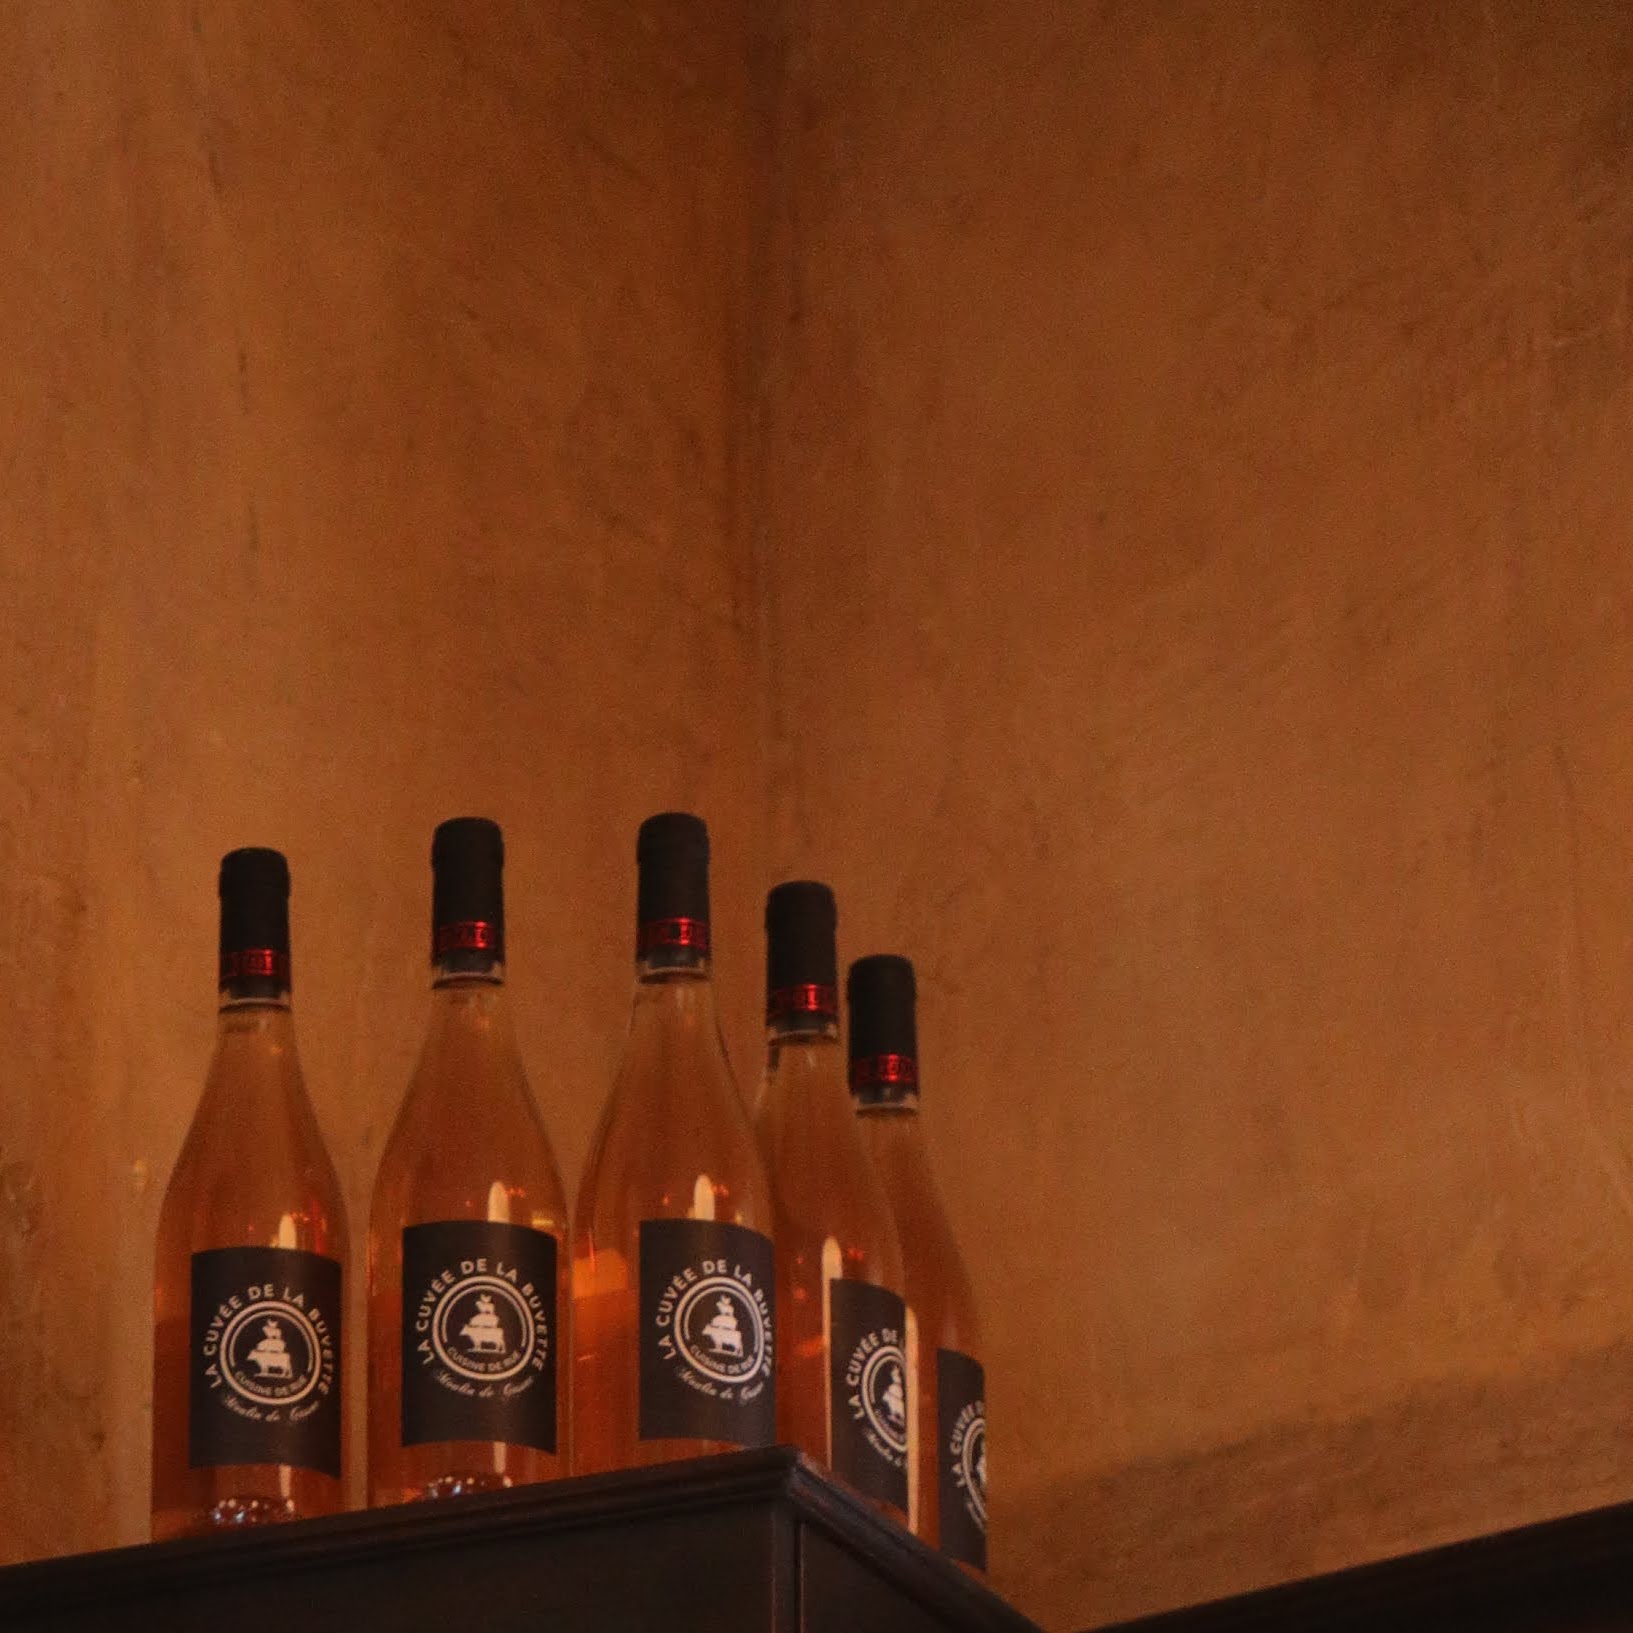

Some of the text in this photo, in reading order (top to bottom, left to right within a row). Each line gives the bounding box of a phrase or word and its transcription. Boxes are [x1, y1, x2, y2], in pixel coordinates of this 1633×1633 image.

[205, 1363, 222, 1389] LA
[247, 1284, 275, 1300] DE
[282, 1286, 305, 1308] LA
[418, 1339, 435, 1365] LA
[460, 1258, 488, 1275] DE
[496, 1261, 518, 1283] LA
[521, 1282, 549, 1371] BUVETTE
[658, 1334, 677, 1360] LA
[701, 1258, 728, 1275] DE
[734, 1264, 753, 1288] LA
[848, 1393, 866, 1420] LA
